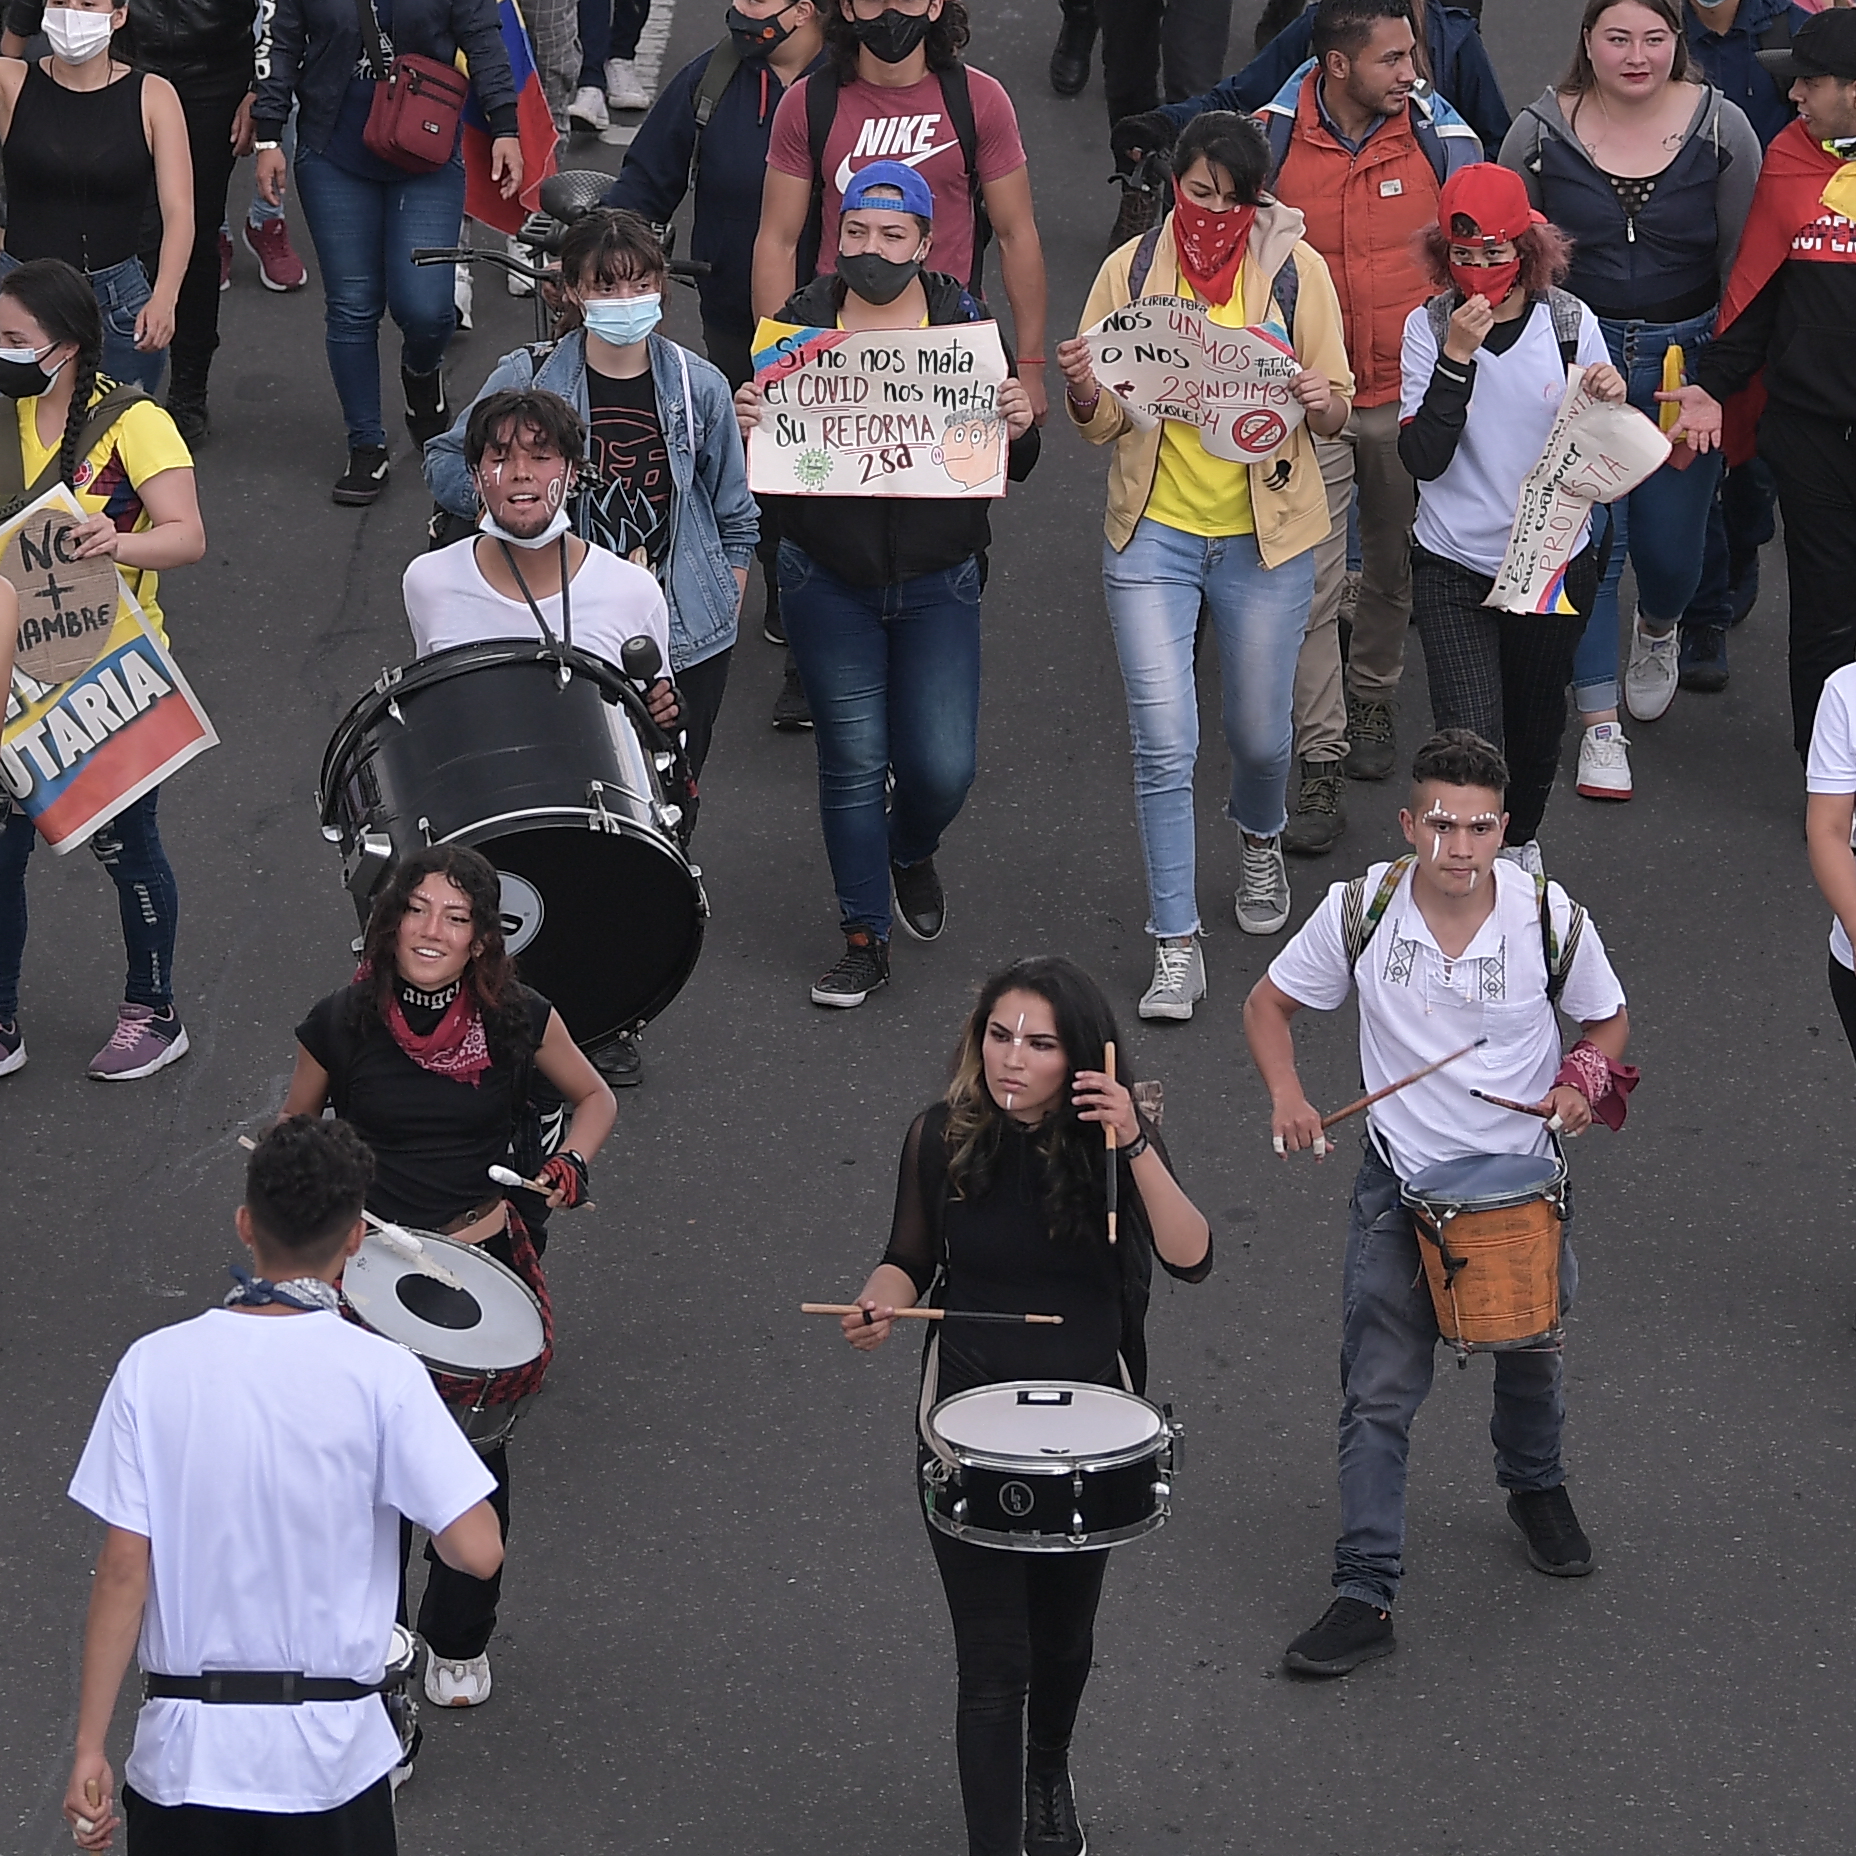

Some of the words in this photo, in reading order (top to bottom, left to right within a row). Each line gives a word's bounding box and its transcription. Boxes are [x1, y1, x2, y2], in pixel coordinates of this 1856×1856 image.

[855, 114, 942, 158] NIKE
[1102, 311, 1153, 334] NOS
[775, 337, 806, 369] Si
[817, 350, 847, 369] no
[860, 348, 906, 373] nos
[918, 338, 974, 375] mata
[1135, 342, 1190, 369] NOS
[764, 379, 789, 405] el
[797, 373, 870, 407] COVID
[884, 382, 925, 403] nos
[933, 380, 995, 411] mata
[776, 413, 807, 448] Su
[822, 414, 936, 450] REFORMA
[1538, 453, 1630, 574] PROTESTA
[403, 980, 460, 1011] angel
